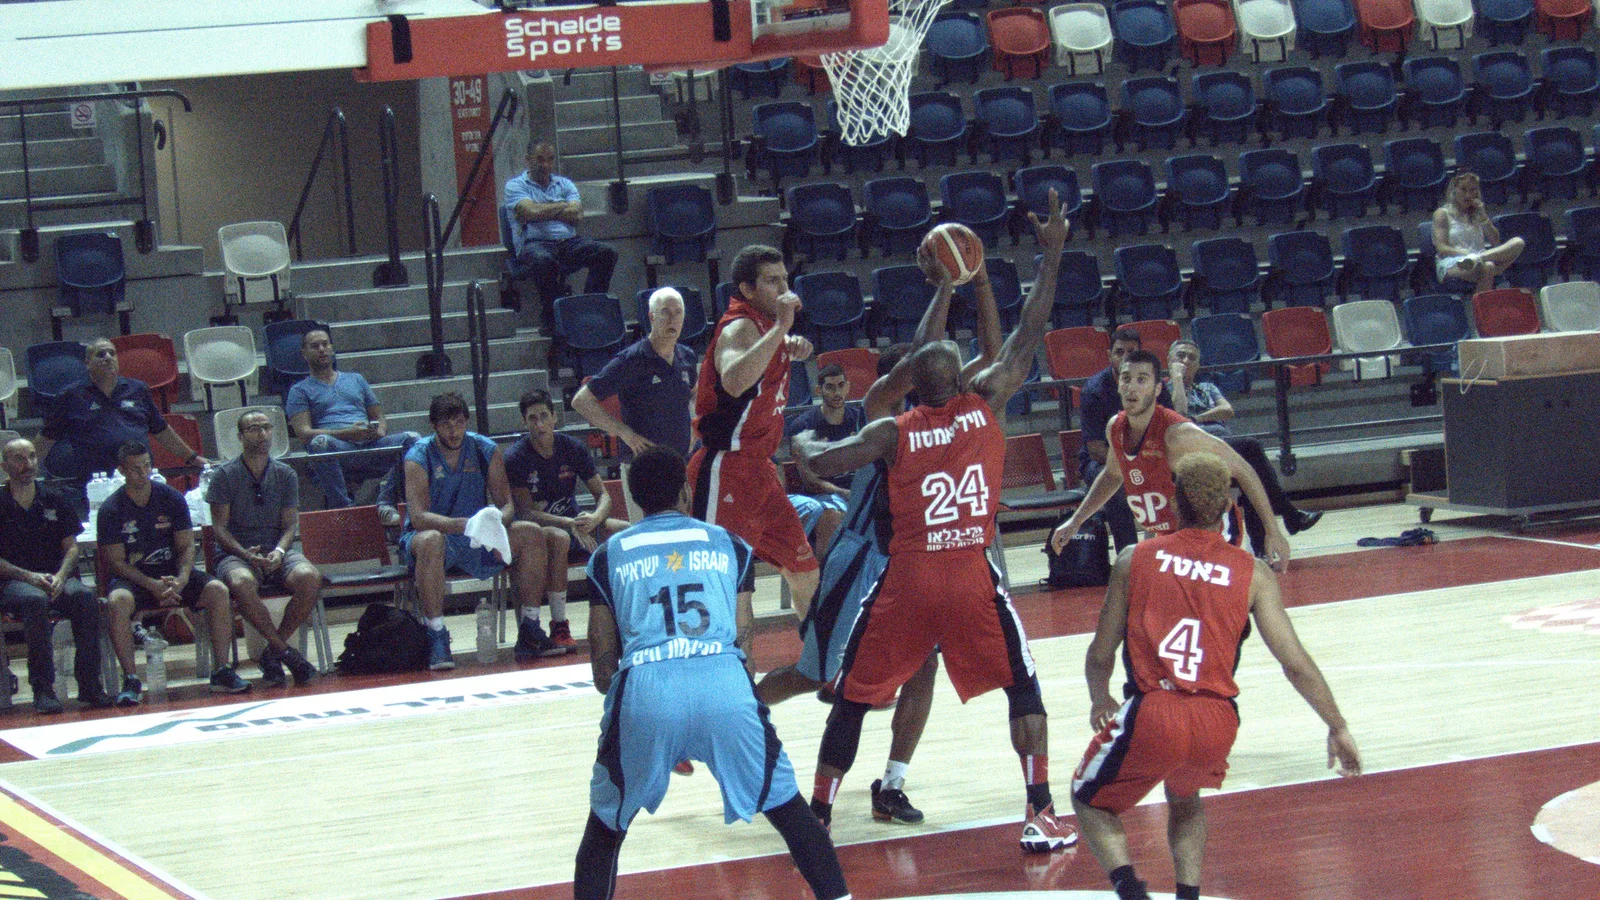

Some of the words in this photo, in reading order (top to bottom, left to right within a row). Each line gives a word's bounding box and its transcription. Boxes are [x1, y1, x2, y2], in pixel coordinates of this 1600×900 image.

[505, 14, 621, 39] Schelde
[506, 33, 622, 61] Sports
[453, 78, 482, 105] 30-49
[1129, 469, 1144, 485] 6
[921, 463, 989, 525] 24
[1127, 491, 1168, 524] SP
[1070, 533, 1096, 541] cron
[689, 550, 729, 574] ISRAIR
[1155, 550, 1231, 587] באטל
[649, 583, 711, 636] 15
[1158, 618, 1203, 682] 4
